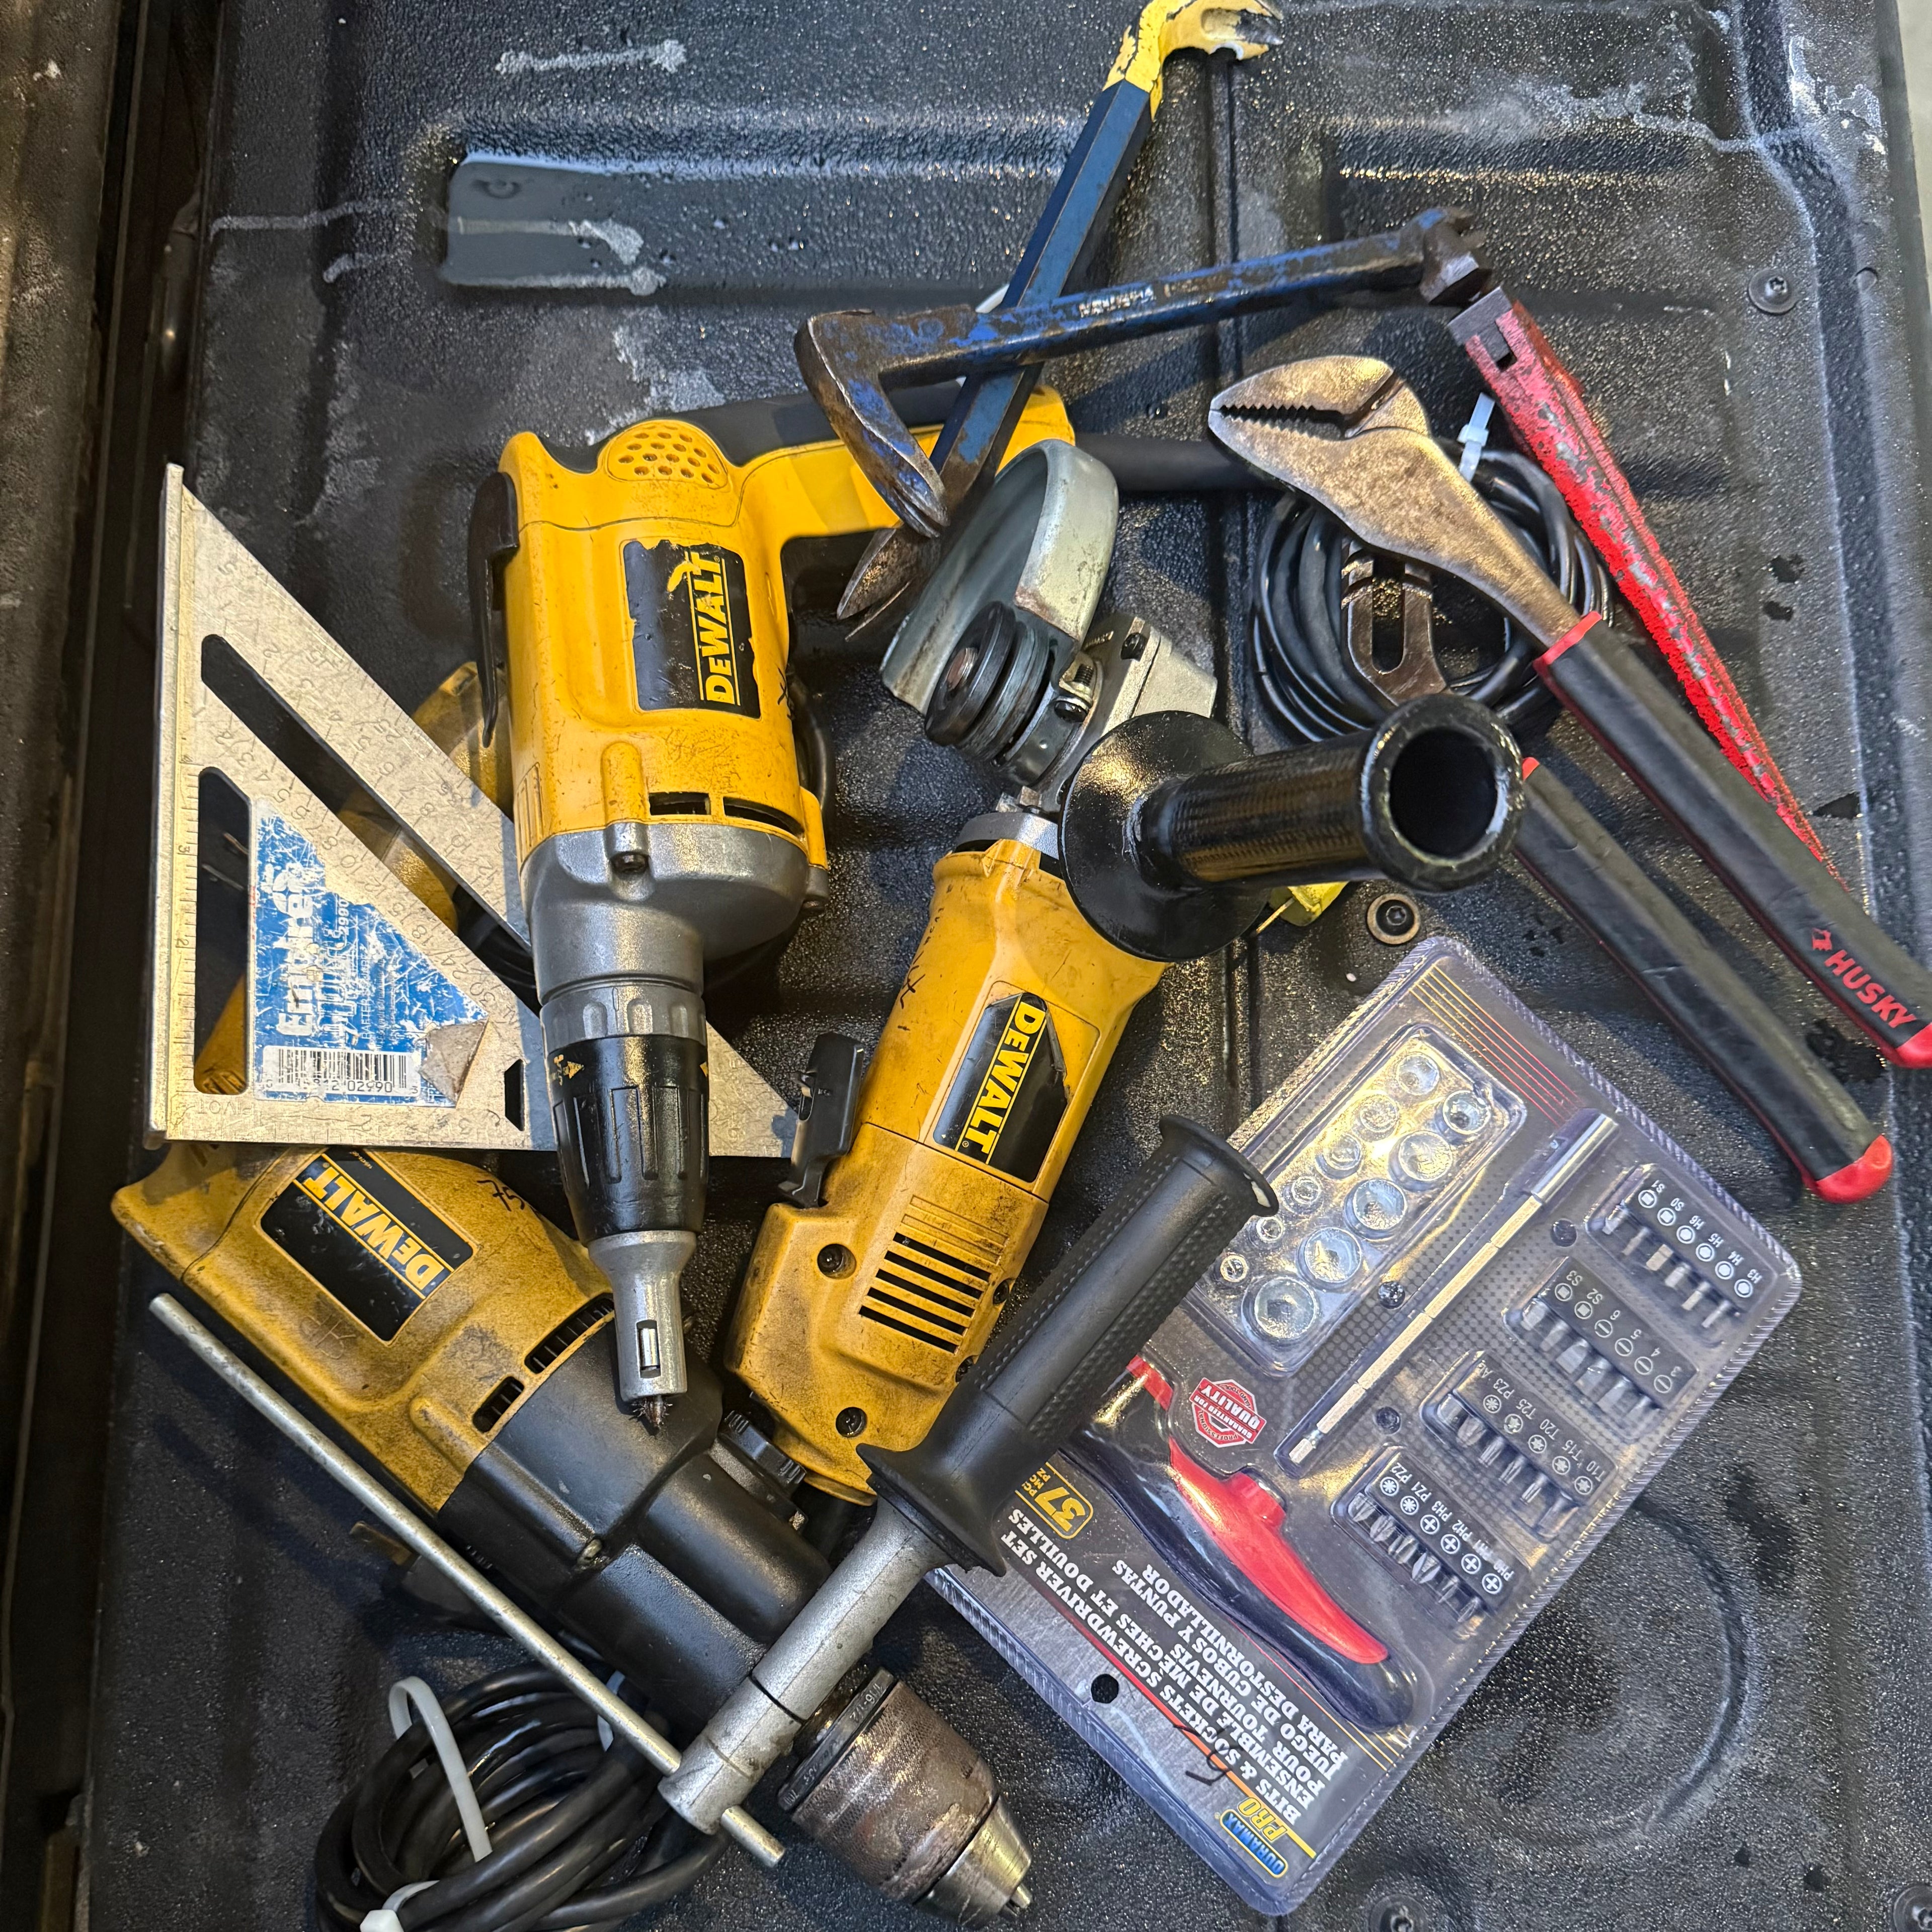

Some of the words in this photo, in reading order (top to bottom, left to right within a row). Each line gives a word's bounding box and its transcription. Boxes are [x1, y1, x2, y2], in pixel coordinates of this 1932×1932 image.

[691, 552, 735, 704] DEWALT
[273, 789, 291, 803] 5
[322, 837, 338, 850] 8
[341, 855, 364, 875] 10
[412, 925, 434, 946] 18
[274, 894, 314, 1035] Empire
[1823, 948, 1918, 1029] HUSKY
[965, 1002, 1046, 1154] DEWALT
[1651, 1178, 1666, 1193] S1
[303, 1167, 444, 1290] DEWALT
[1688, 1213, 1706, 1230] H6
[1707, 1231, 1725, 1248] H5
[1726, 1249, 1744, 1266] H4
[1565, 1268, 1583, 1287] S3
[1746, 1266, 1763, 1284] H3
[1585, 1287, 1604, 1306] S2
[1608, 1308, 1622, 1321] 6
[1630, 1327, 1642, 1340] 5
[1650, 1346, 1662, 1359] 4
[1669, 1364, 1682, 1378] 3
[1193, 1394, 1209, 1408] FOR
[1492, 1377, 1515, 1399] PZ3
[1200, 1384, 1261, 1430] QUALITY
[1207, 1404, 1253, 1438] GUARANTEED
[1515, 1397, 1539, 1420] T25
[1197, 1410, 1237, 1439] PROFESSIONAL
[1538, 1417, 1562, 1440] T20
[1561, 1438, 1585, 1461] T15
[1389, 1461, 1413, 1484] PZ2
[1584, 1459, 1607, 1482] T10
[1033, 1478, 1089, 1533] 37
[1410, 1480, 1432, 1502] PZ1
[1429, 1499, 1454, 1522] PH3
[1450, 1518, 1474, 1542] PH2
[1000, 1527, 1038, 1567] SET
[1006, 1506, 1095, 1592] DOUILLES
[1089, 1586, 1119, 1618] ET
[1110, 1558, 1182, 1629] PUNTAS
[1033, 1560, 1163, 1688] SCREWDRIVER
[1177, 1623, 1197, 1643] Y
[1112, 1611, 1192, 1692] MÈCHES
[1139, 1563, 1300, 1721] DESTORNILLADOR
[1189, 1635, 1254, 1699] CUBOS
[1168, 1641, 1271, 1743] TOURNEVIS
[1187, 1683, 1221, 1717] DE
[1157, 1682, 1242, 1766] SOCKETS
[1249, 1693, 1282, 1726] DE
[1277, 1718, 1341, 1782] JUEGO
[1294, 1713, 1348, 1767] PARA
[1215, 1710, 1316, 1810] ENSEMBLE
[1238, 1760, 1257, 1781] &
[1268, 1739, 1327, 1797] POUR
[1253, 1777, 1303, 1825] BITS
[1239, 1797, 1286, 1842] PRO
